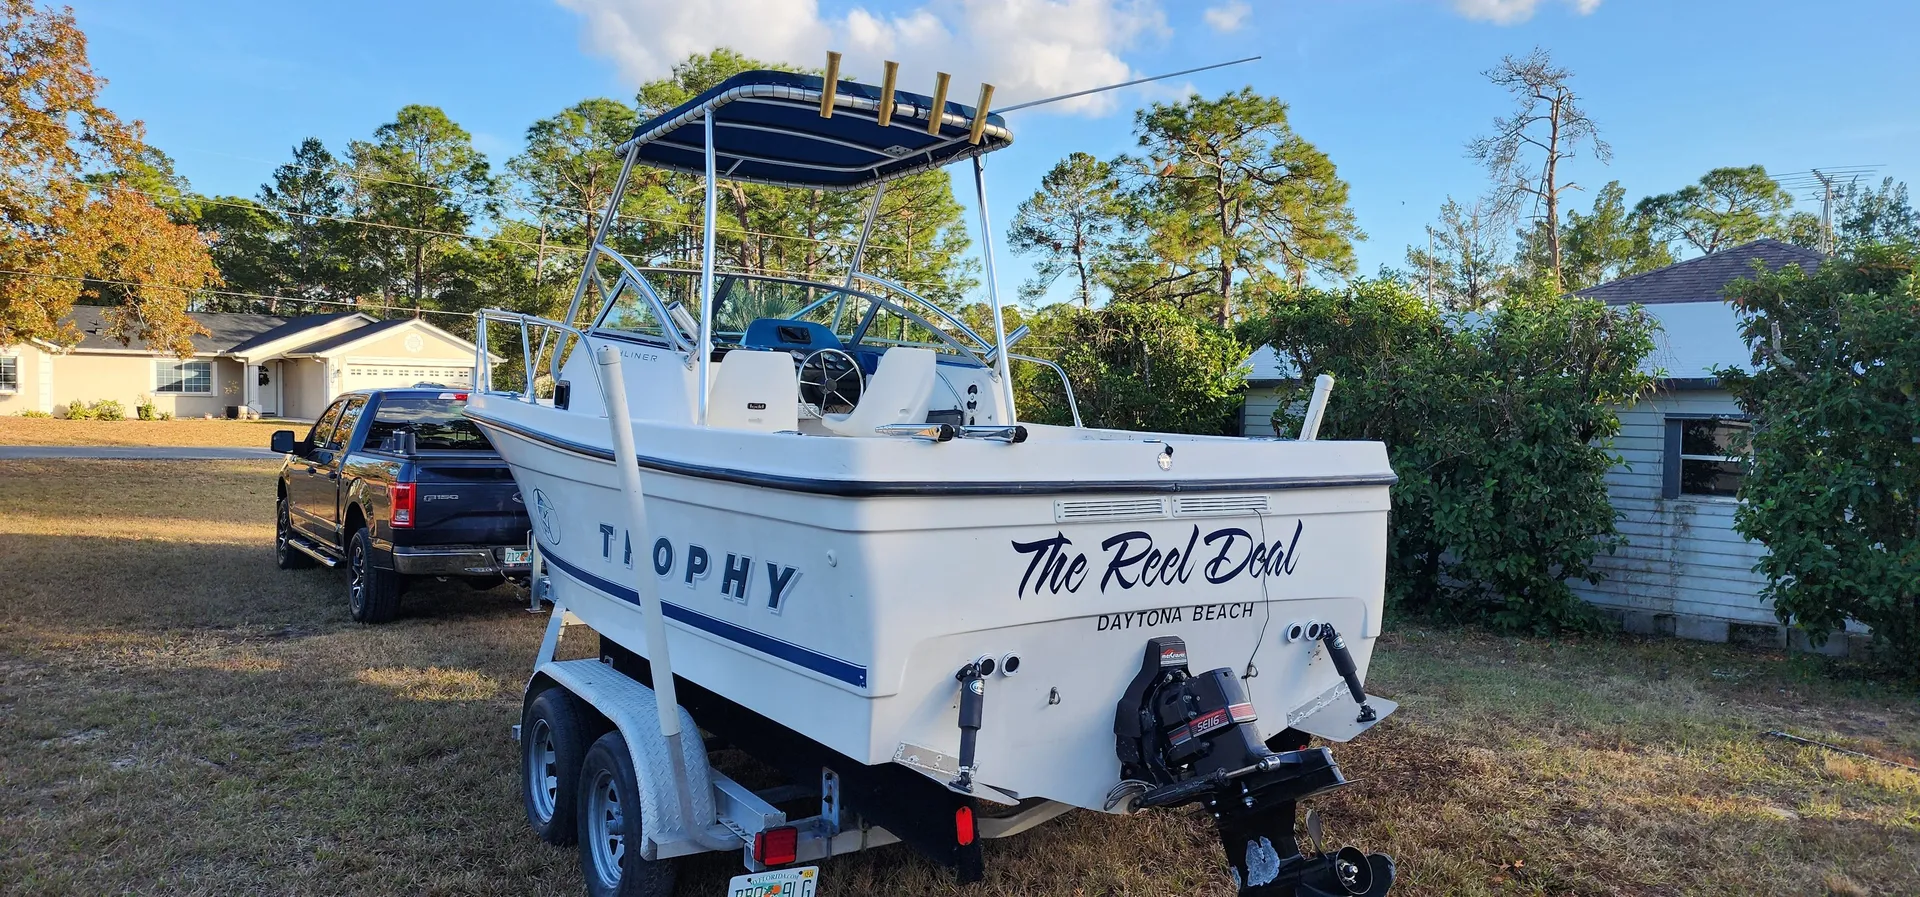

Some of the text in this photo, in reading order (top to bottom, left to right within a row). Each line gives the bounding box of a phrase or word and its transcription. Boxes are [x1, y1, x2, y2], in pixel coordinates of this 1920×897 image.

[1011, 518, 1303, 600] The Reel Deal
[1097, 602, 1254, 632] DAYTONA BEACH
